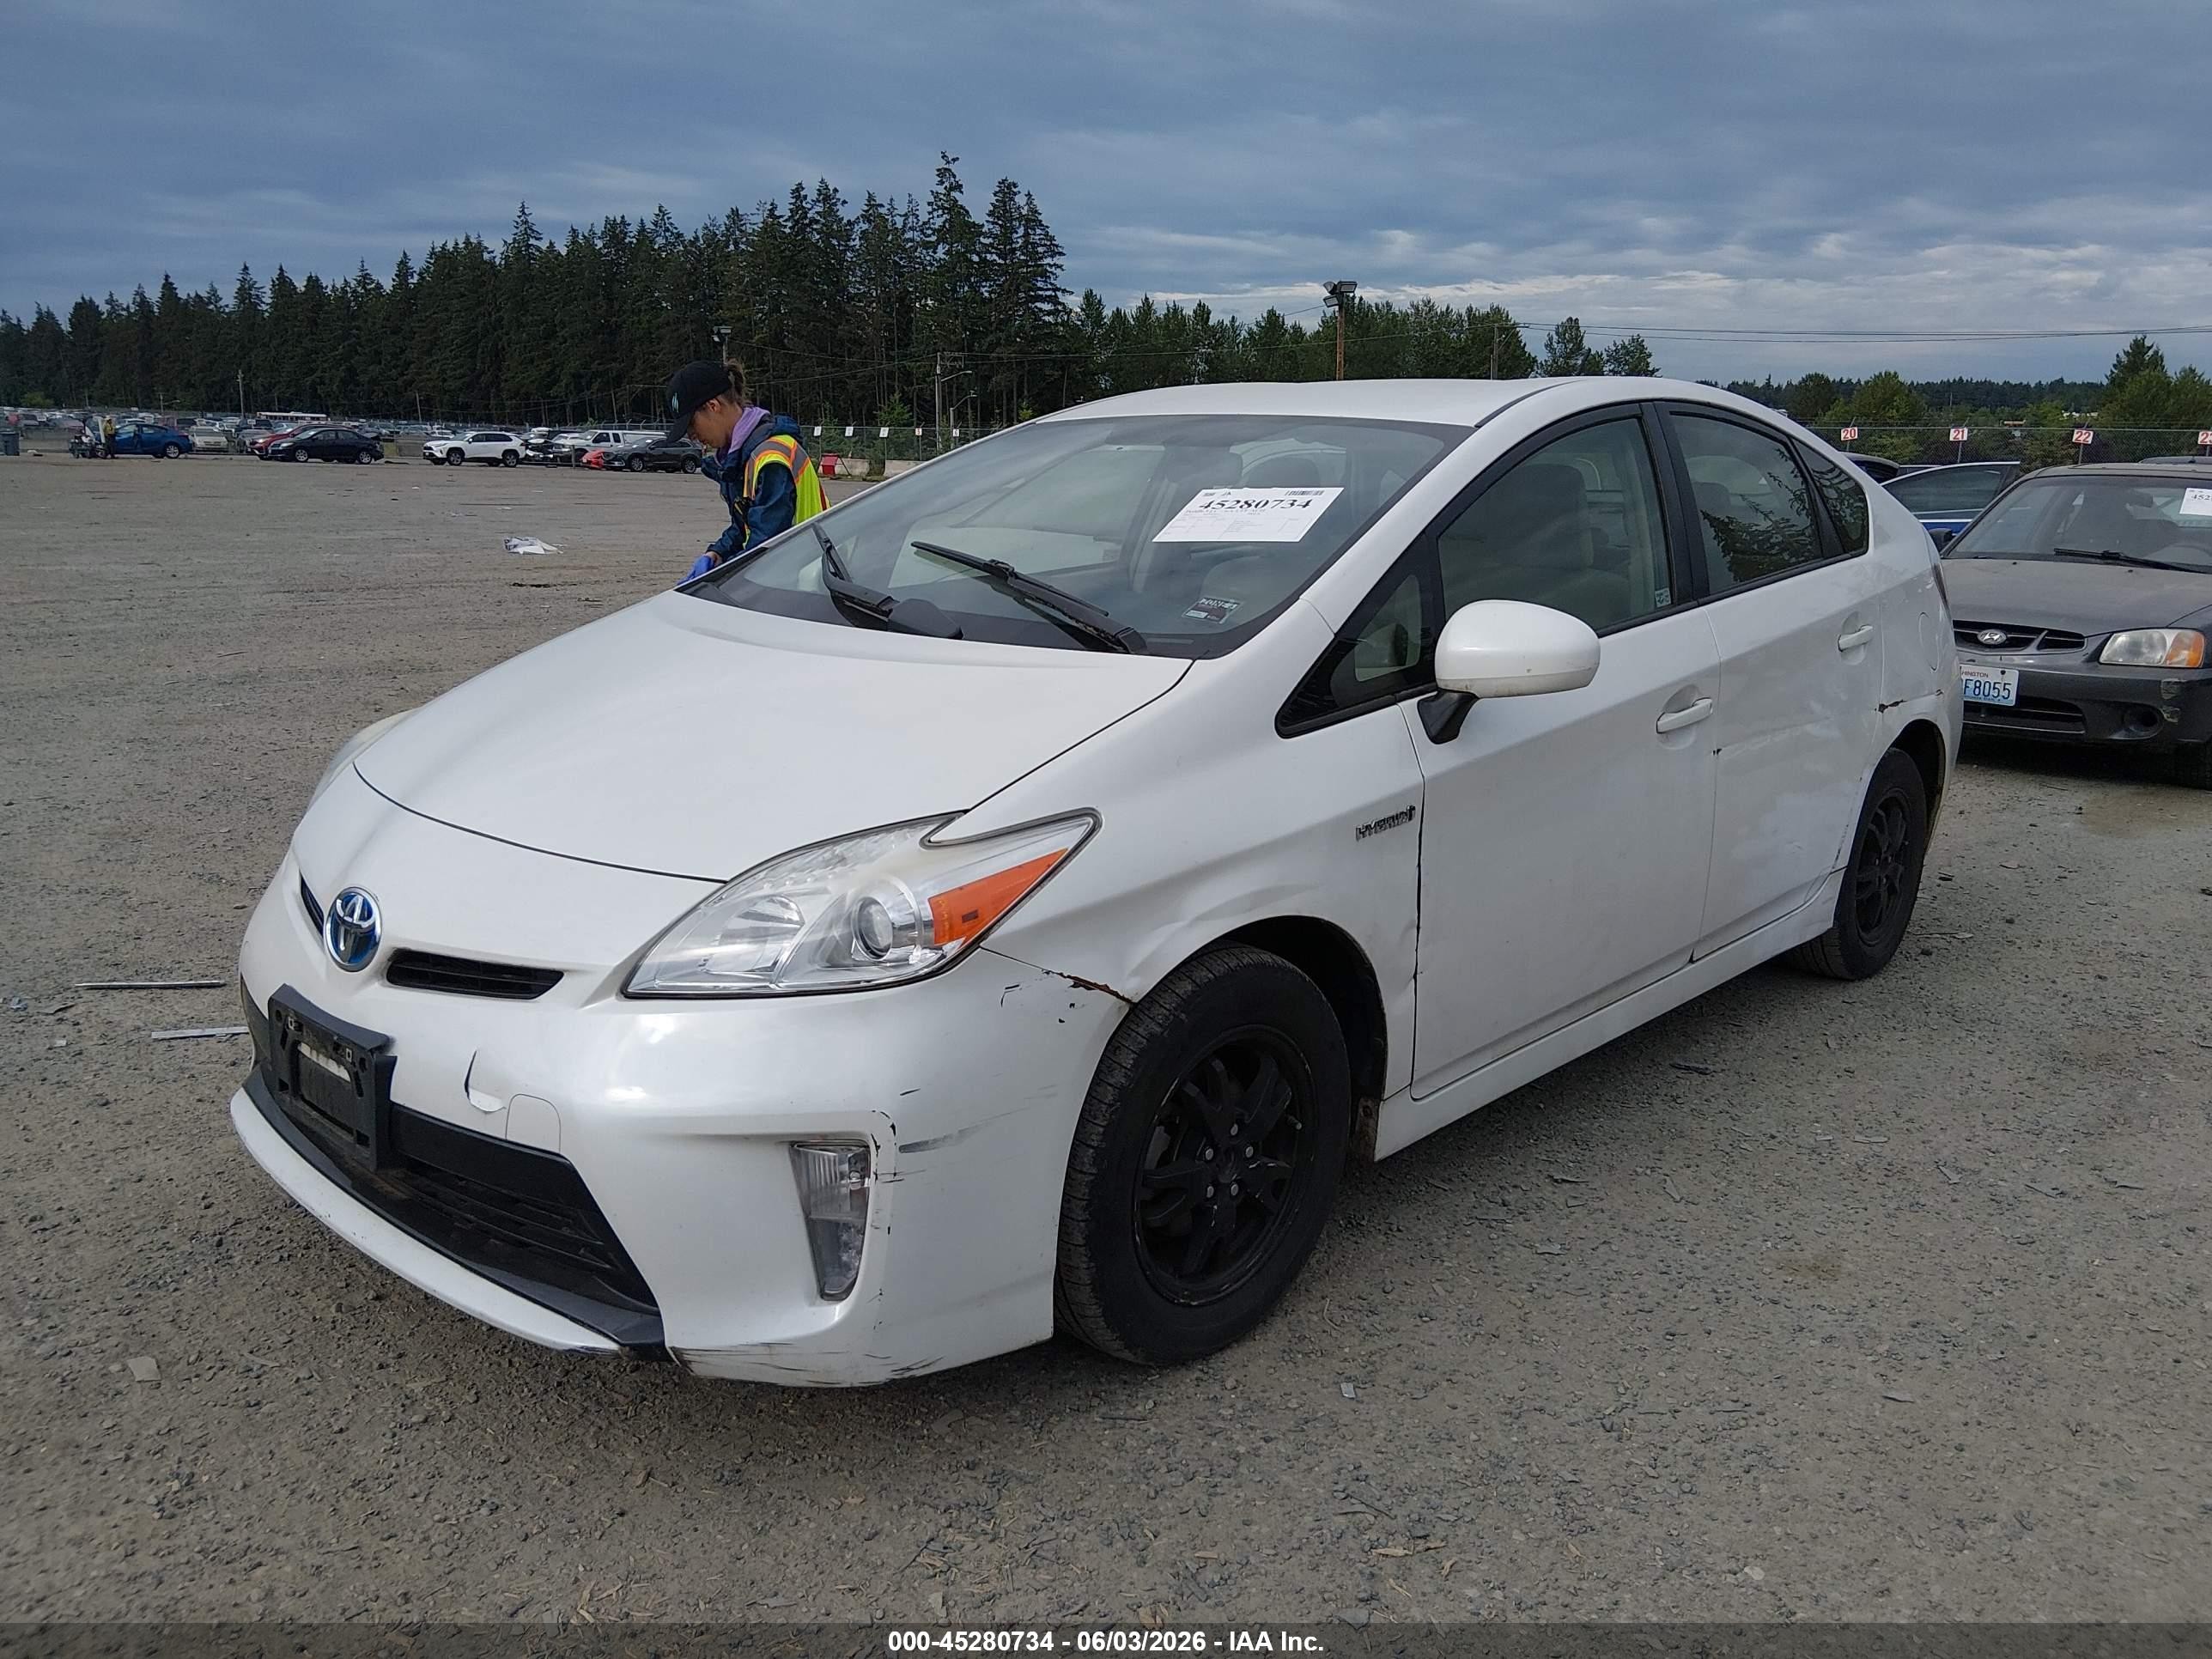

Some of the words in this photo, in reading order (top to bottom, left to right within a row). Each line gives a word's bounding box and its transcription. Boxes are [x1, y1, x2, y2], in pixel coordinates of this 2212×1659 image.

[1842, 428, 1856, 440] 20
[1953, 429, 1965, 440] 21
[2075, 430, 2092, 442] 22
[1200, 499, 1313, 509] 45280734
[1963, 678, 2012, 700] F8055
